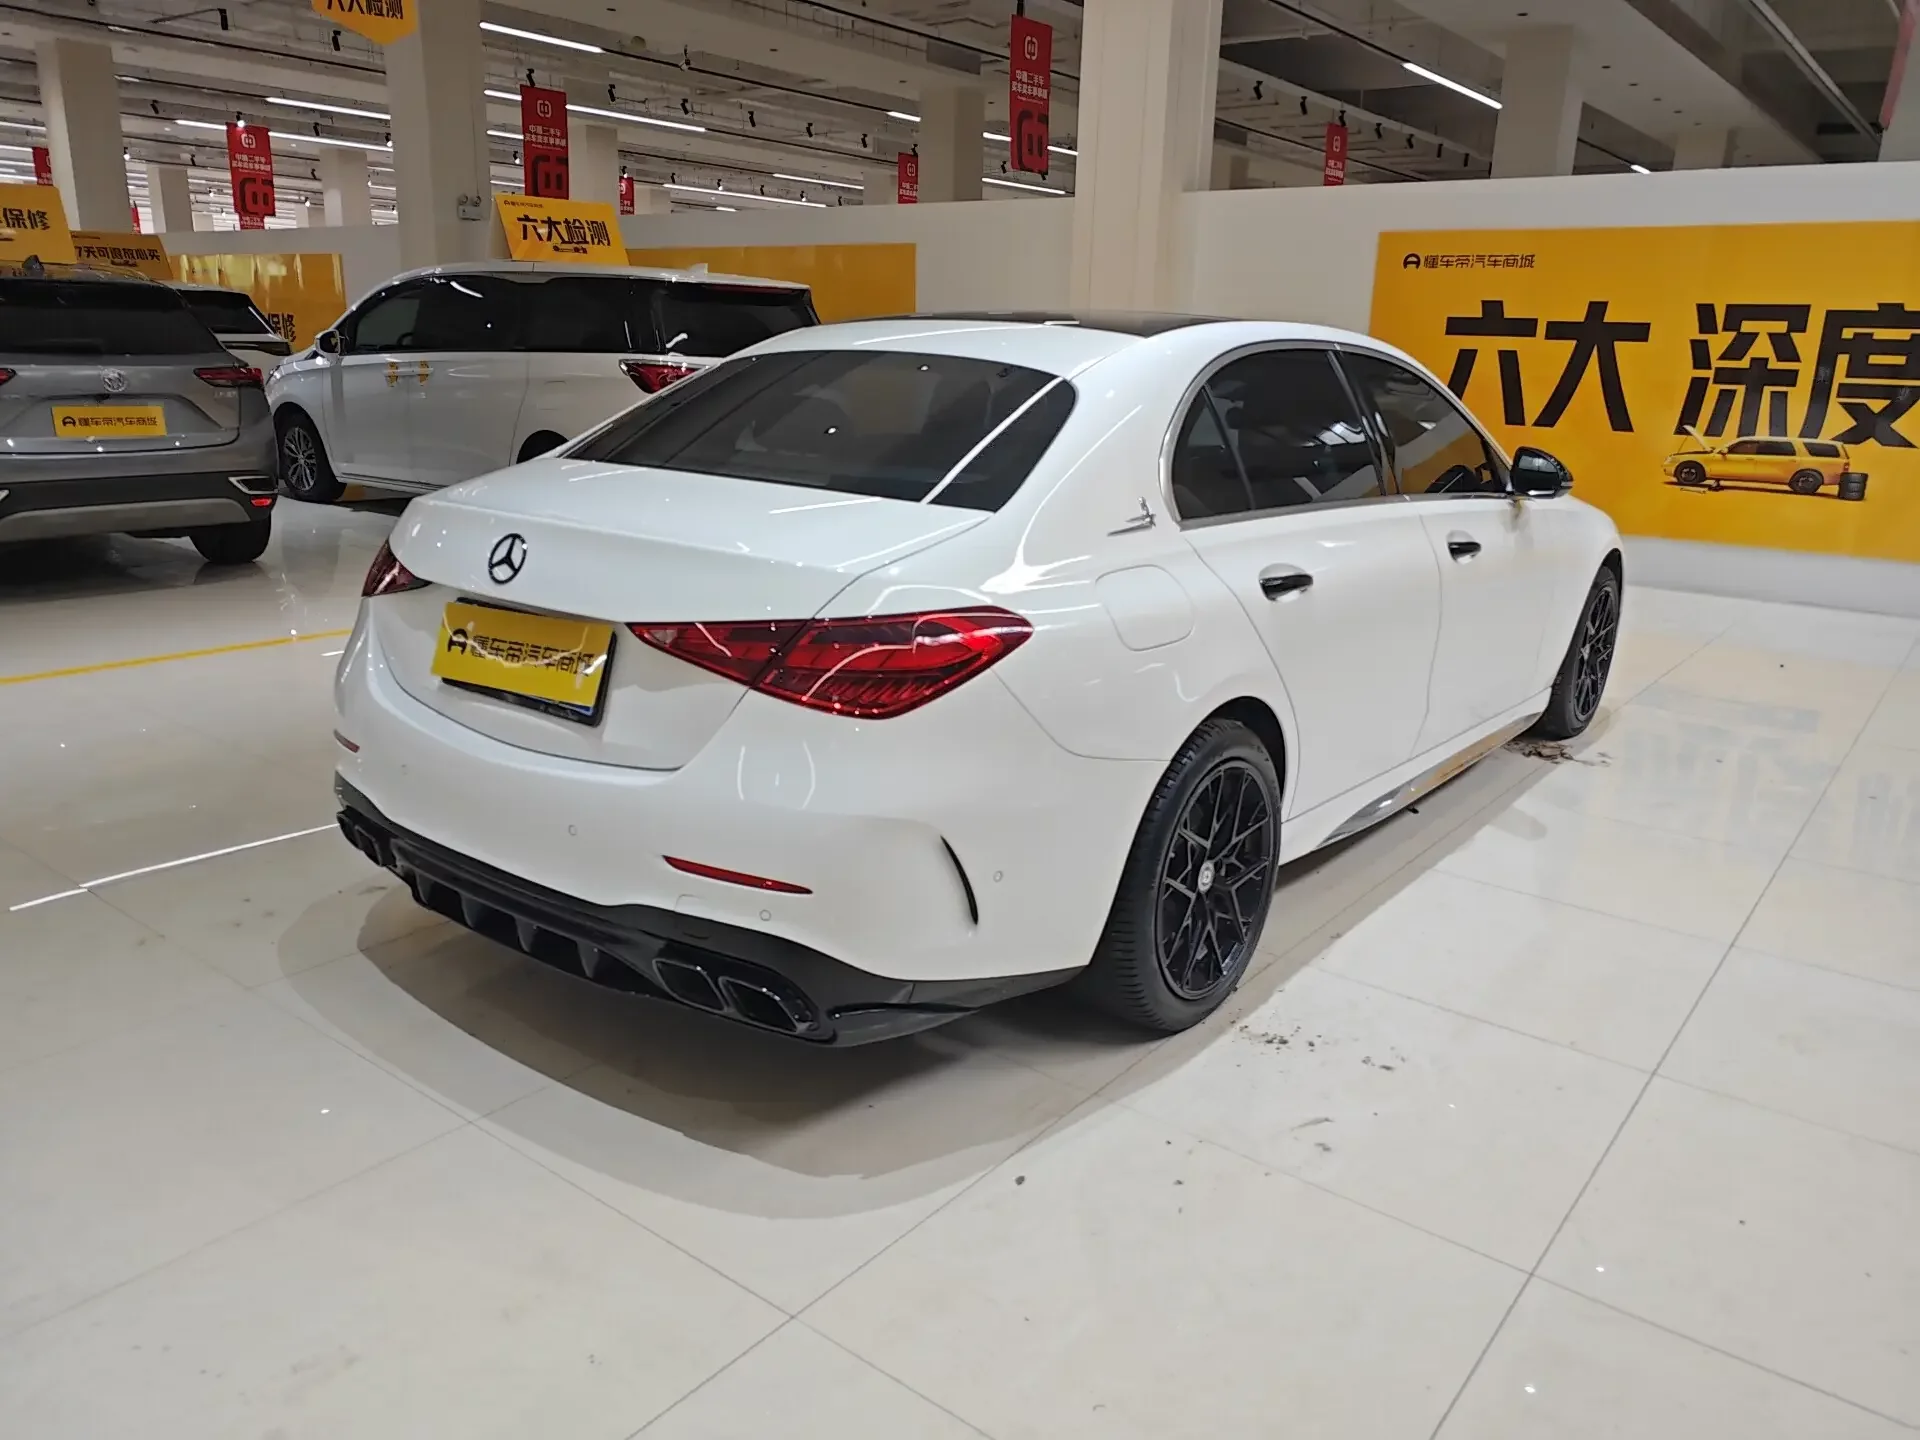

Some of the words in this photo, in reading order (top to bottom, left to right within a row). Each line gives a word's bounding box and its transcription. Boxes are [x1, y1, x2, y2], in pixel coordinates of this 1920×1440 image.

[0, 207, 50, 230] 保修
[516, 214, 611, 246] 六大检测
[1423, 254, 1536, 269] 懂车帝汽车商城
[1445, 300, 1652, 433] 六大
[1673, 302, 1920, 449] 深度
